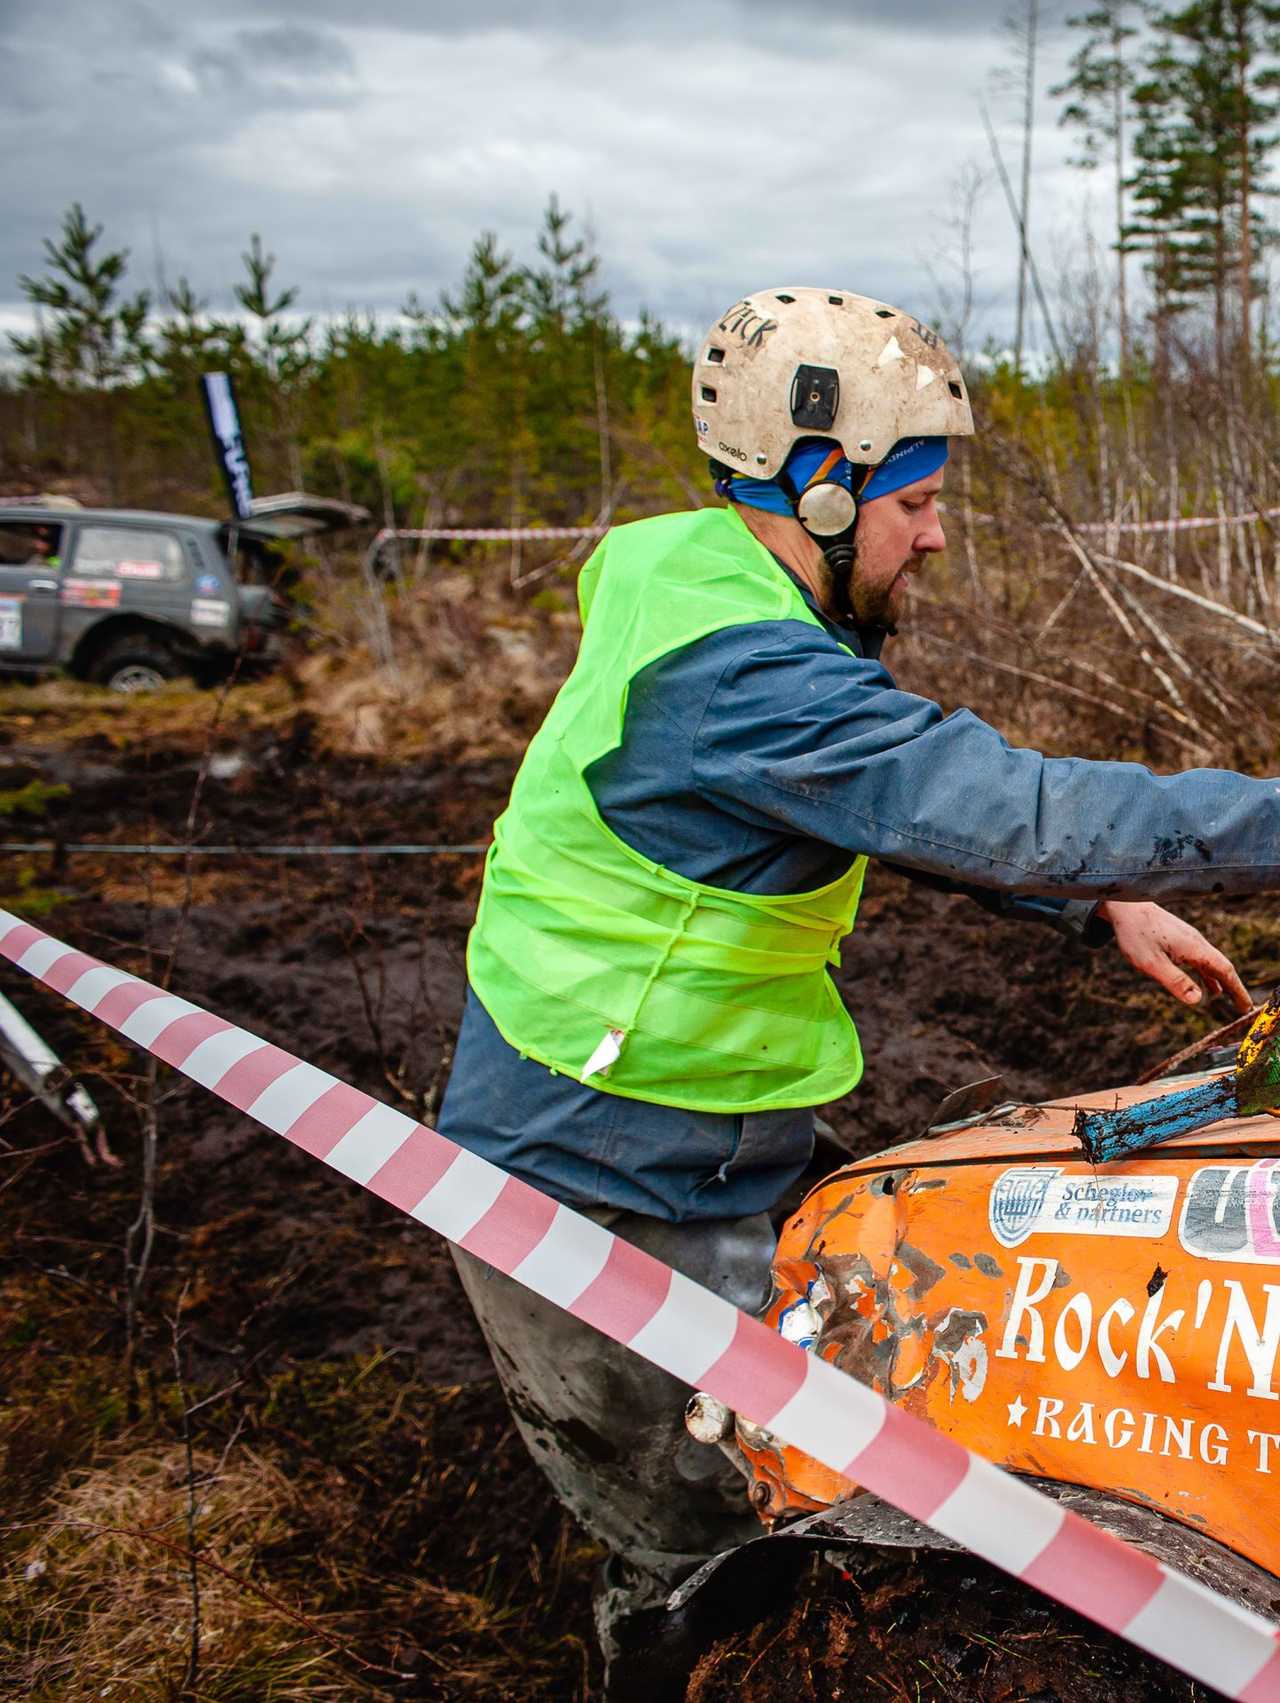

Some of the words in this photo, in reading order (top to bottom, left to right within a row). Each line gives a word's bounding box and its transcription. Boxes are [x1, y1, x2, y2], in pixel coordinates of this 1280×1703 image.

[718, 441, 748, 462] oxelo
[1053, 1202, 1071, 1220] &
[1077, 1205, 1163, 1225] partners
[1031, 1396, 1230, 1466] RACING
